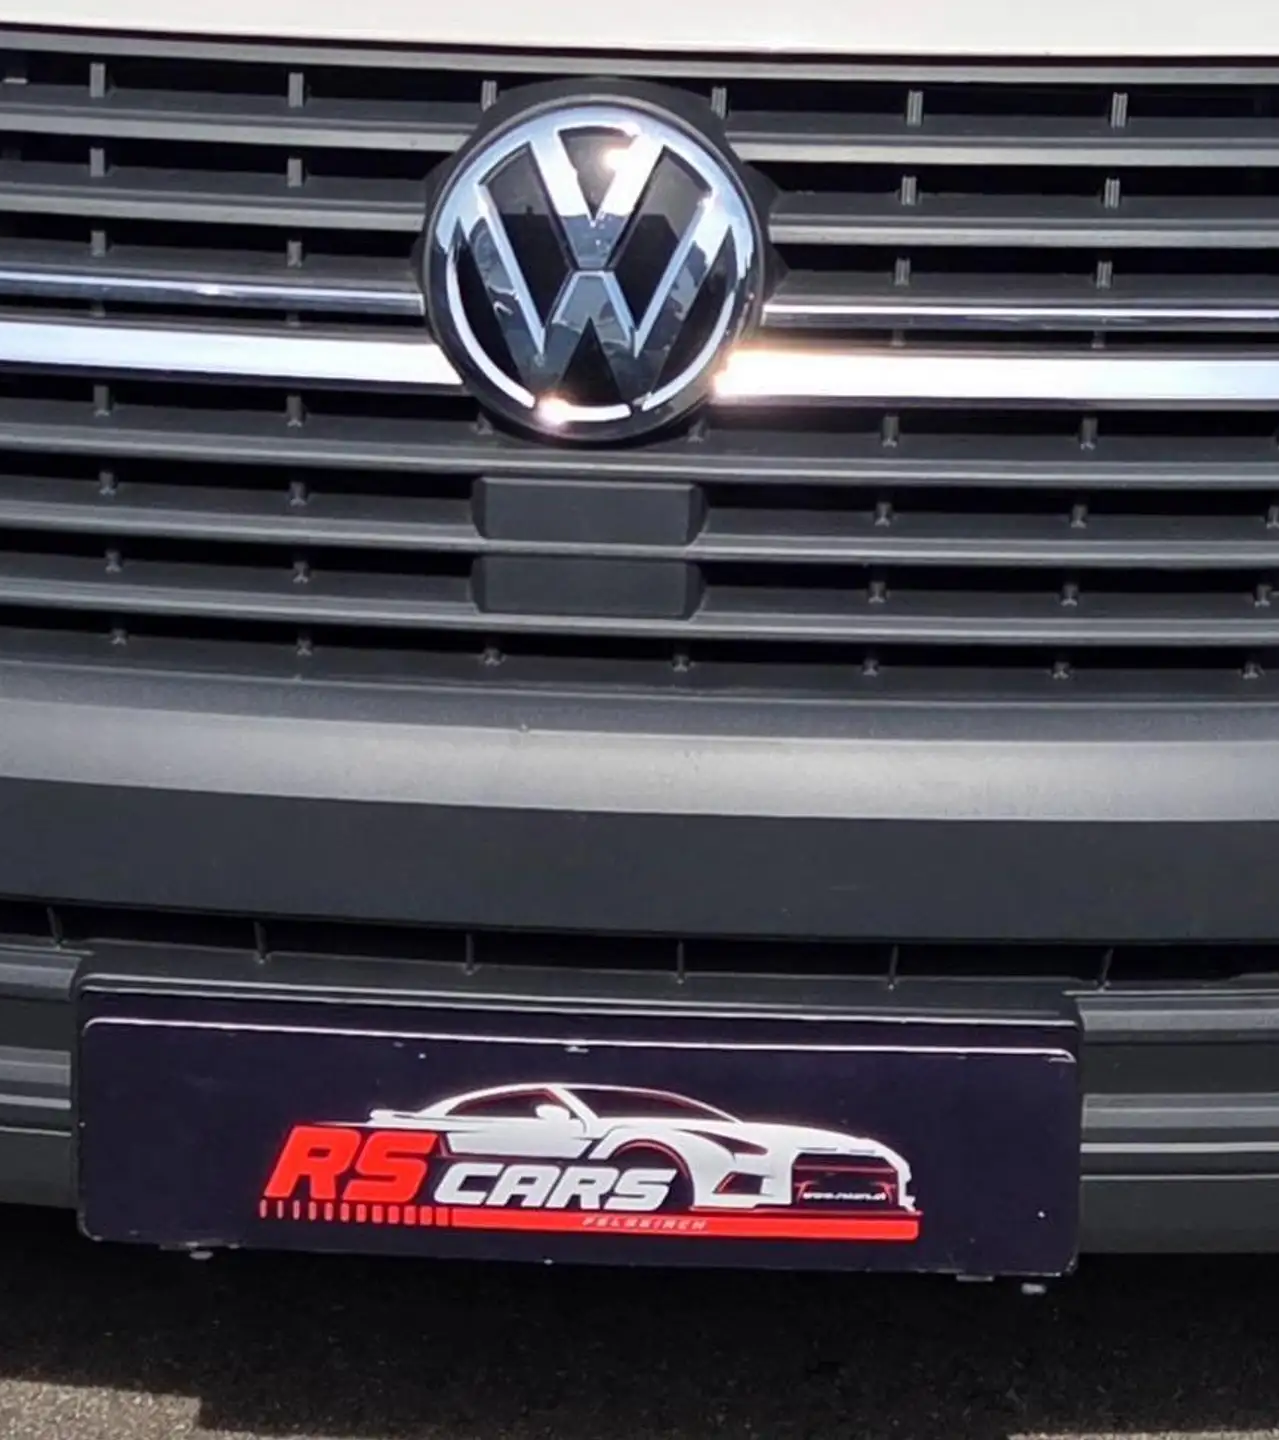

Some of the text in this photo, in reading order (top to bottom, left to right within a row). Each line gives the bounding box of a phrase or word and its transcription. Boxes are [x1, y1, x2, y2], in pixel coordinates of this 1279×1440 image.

[440, 118, 750, 426] VW
[263, 1125, 439, 1203] RS
[433, 1161, 678, 1211] CARS
